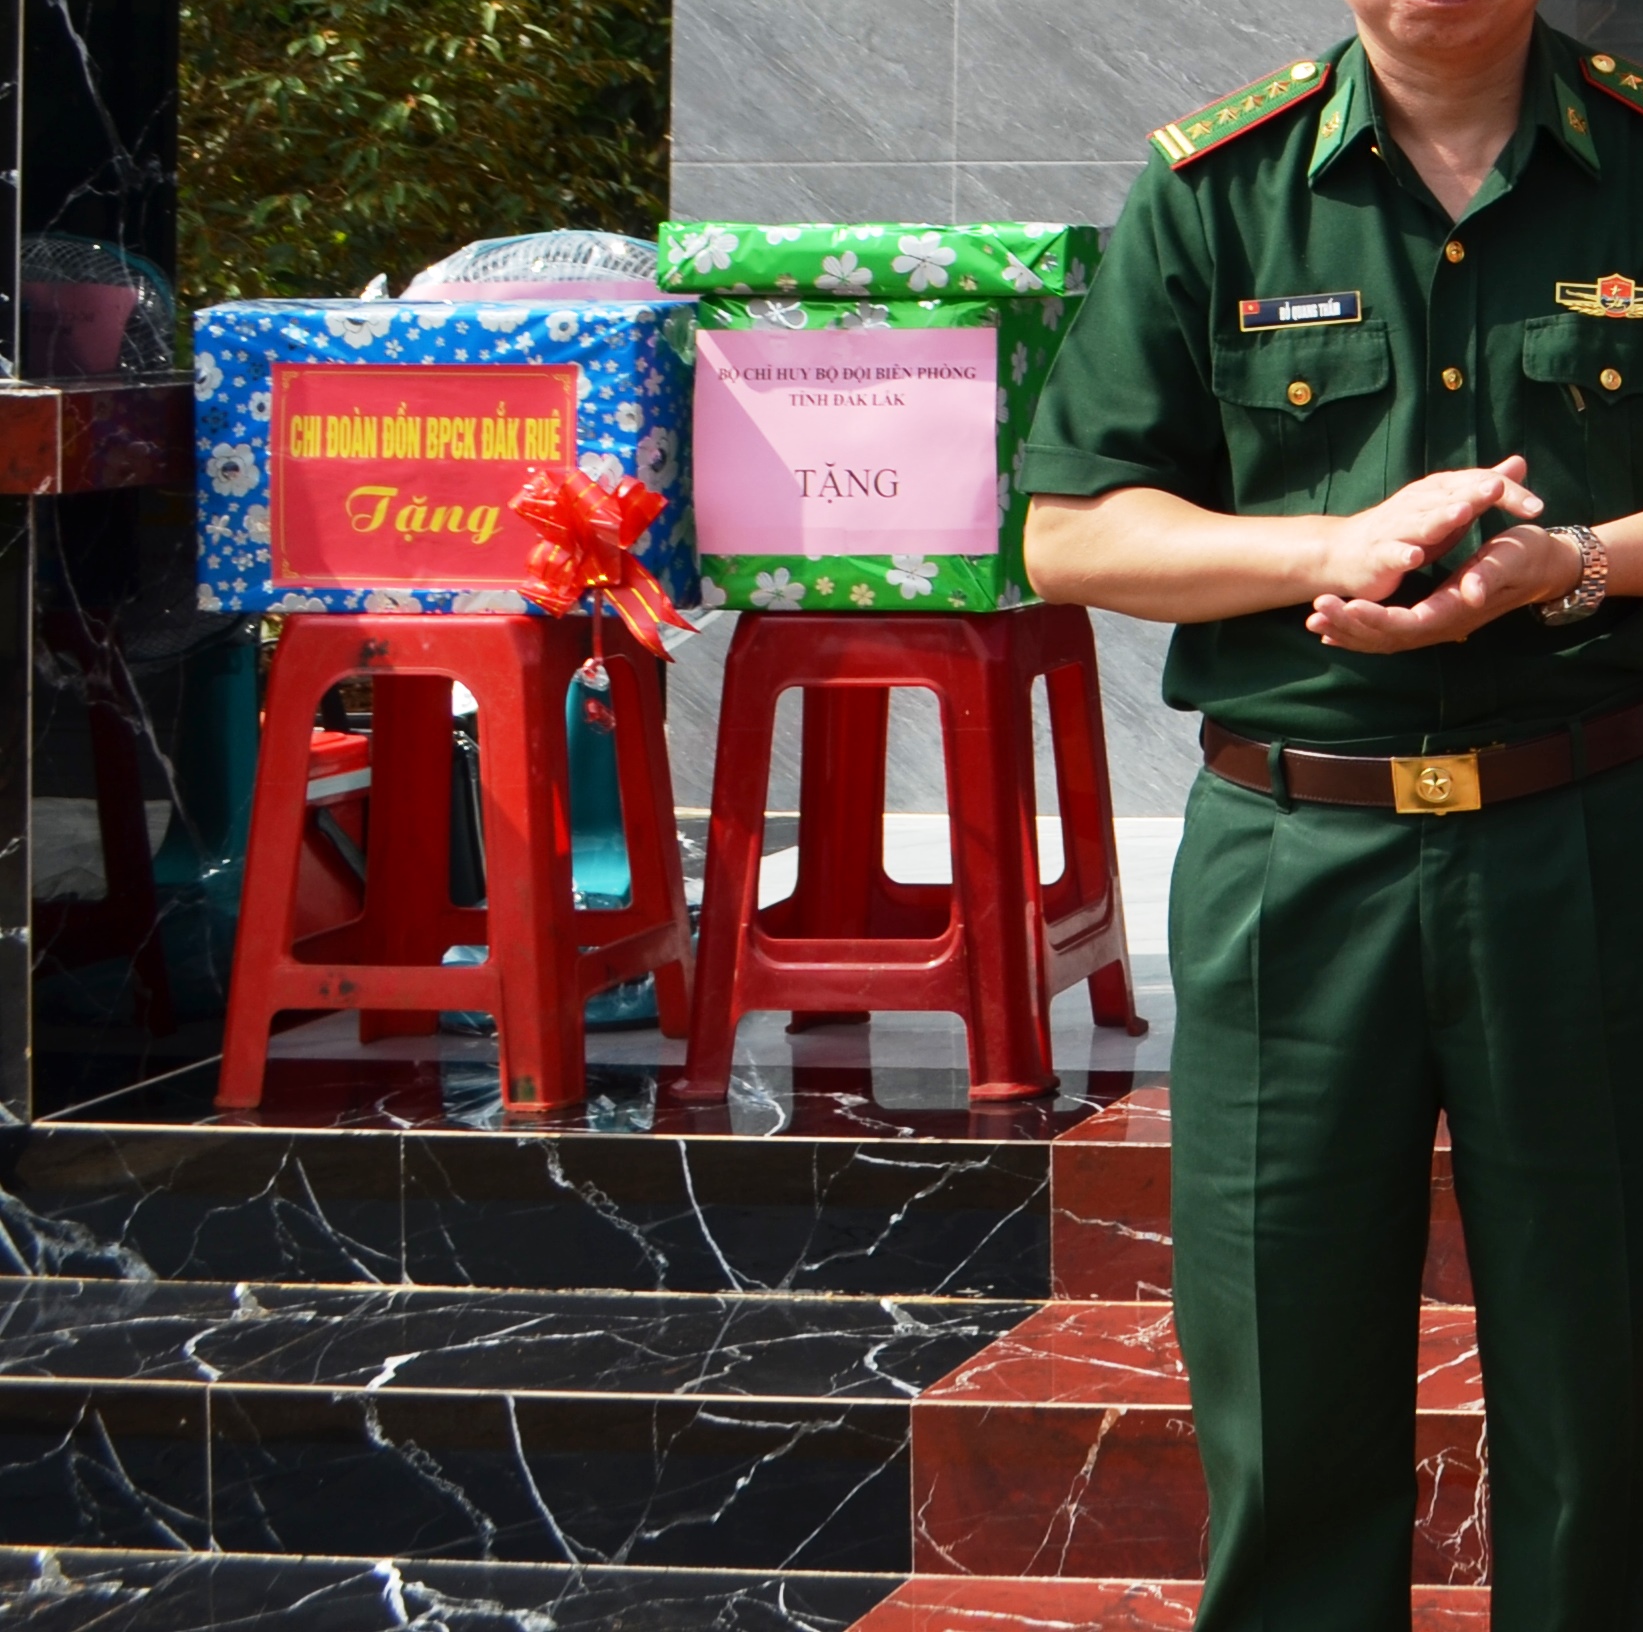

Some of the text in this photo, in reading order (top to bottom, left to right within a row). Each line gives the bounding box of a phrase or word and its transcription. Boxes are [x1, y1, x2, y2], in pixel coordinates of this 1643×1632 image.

[718, 367, 740, 383] BỘ
[777, 368, 811, 381] HUY
[815, 367, 838, 383] BỘ
[842, 366, 872, 383] ĐỘI
[876, 363, 914, 380] BIÊN
[917, 364, 976, 380] PHÒNG
[290, 400, 561, 461] CHI ĐOÀN ĐỒN BPCK ĐẮK RUÊ
[794, 461, 900, 504] TẶNG
[345, 485, 504, 545] Tặng
